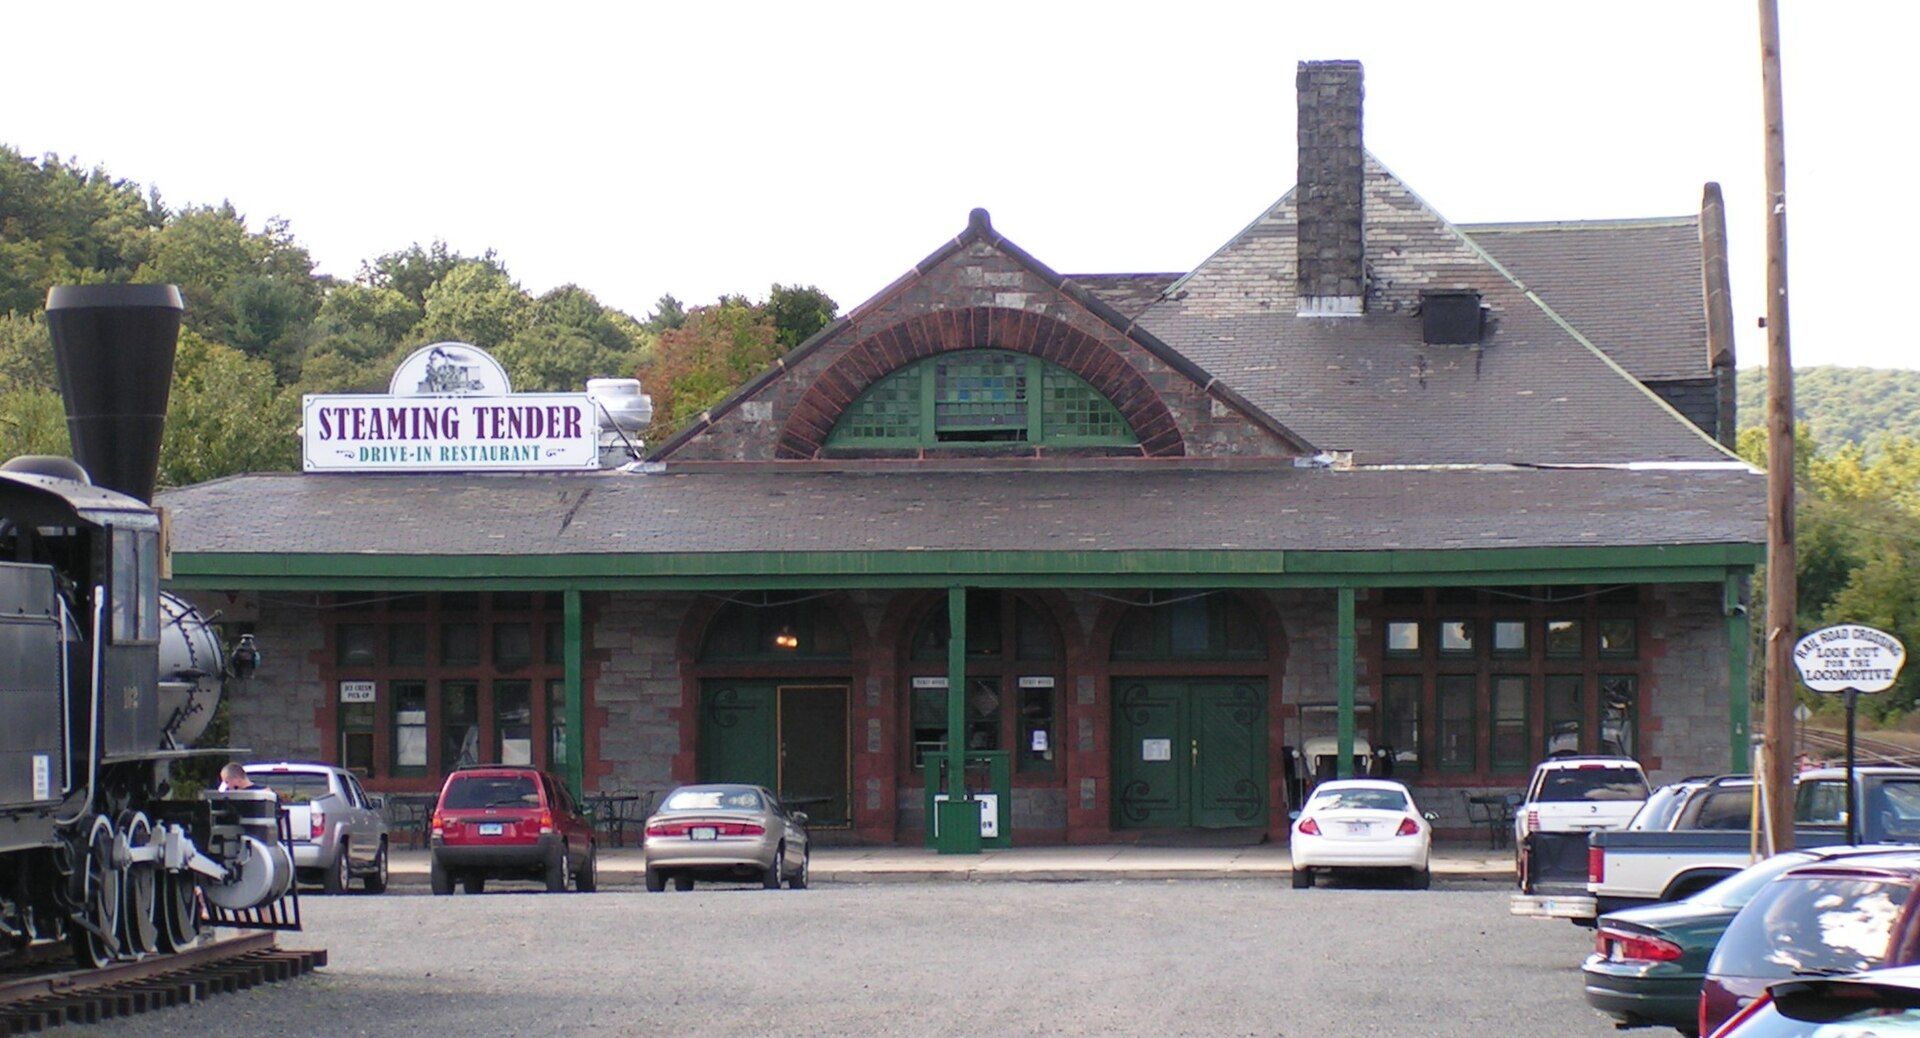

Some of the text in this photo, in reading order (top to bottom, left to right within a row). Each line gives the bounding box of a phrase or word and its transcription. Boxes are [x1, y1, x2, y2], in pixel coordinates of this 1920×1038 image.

[319, 405, 582, 441] STEAMING TENDER
[359, 444, 541, 462] DRIVE-IN RESTAURANT
[1819, 629, 1848, 643] ROAD
[1816, 646, 1879, 658] LOOK OUT
[1850, 659, 1871, 667] THE
[1805, 669, 1892, 681] LOCOMOTIVE
